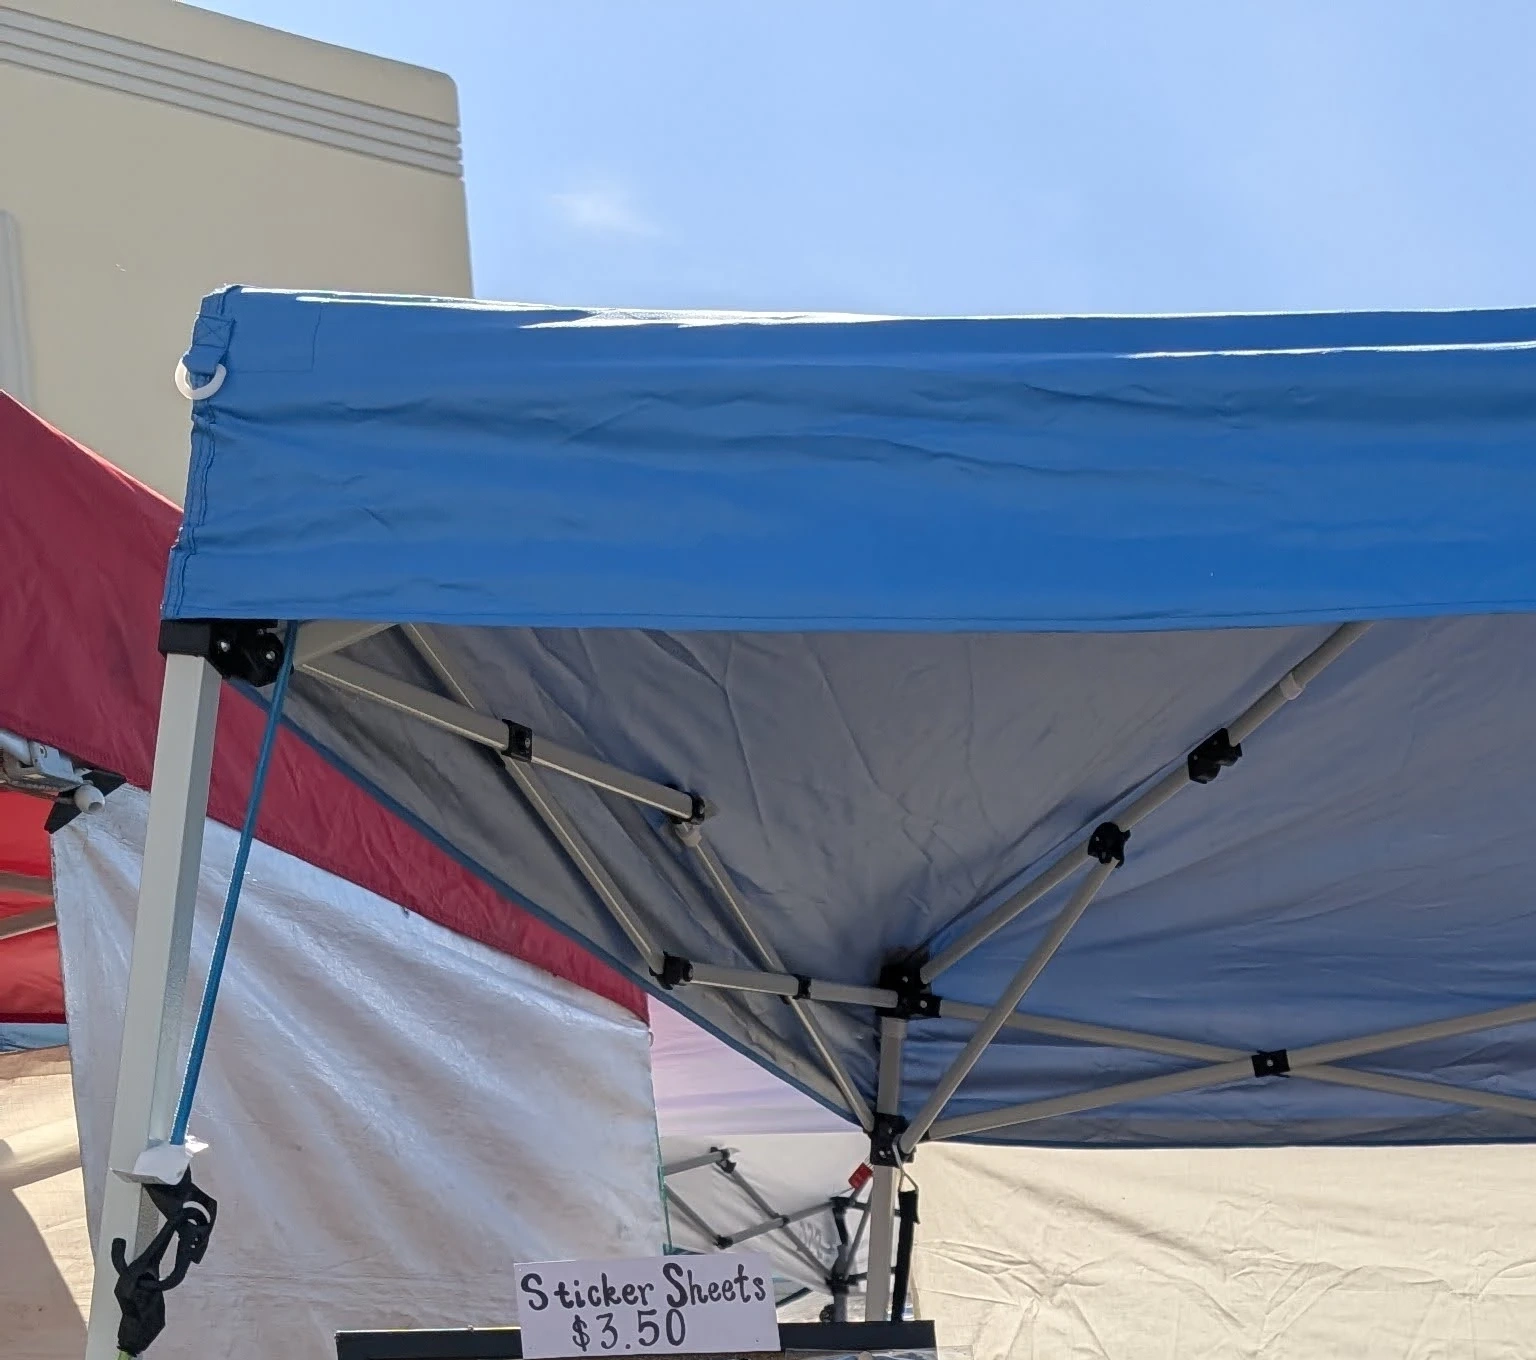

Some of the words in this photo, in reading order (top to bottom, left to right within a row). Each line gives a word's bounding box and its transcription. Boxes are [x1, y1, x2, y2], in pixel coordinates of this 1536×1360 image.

[520, 1272, 655, 1311] Sticker
[662, 1262, 767, 1308] Sheets
[571, 1308, 687, 1352] $3.50
